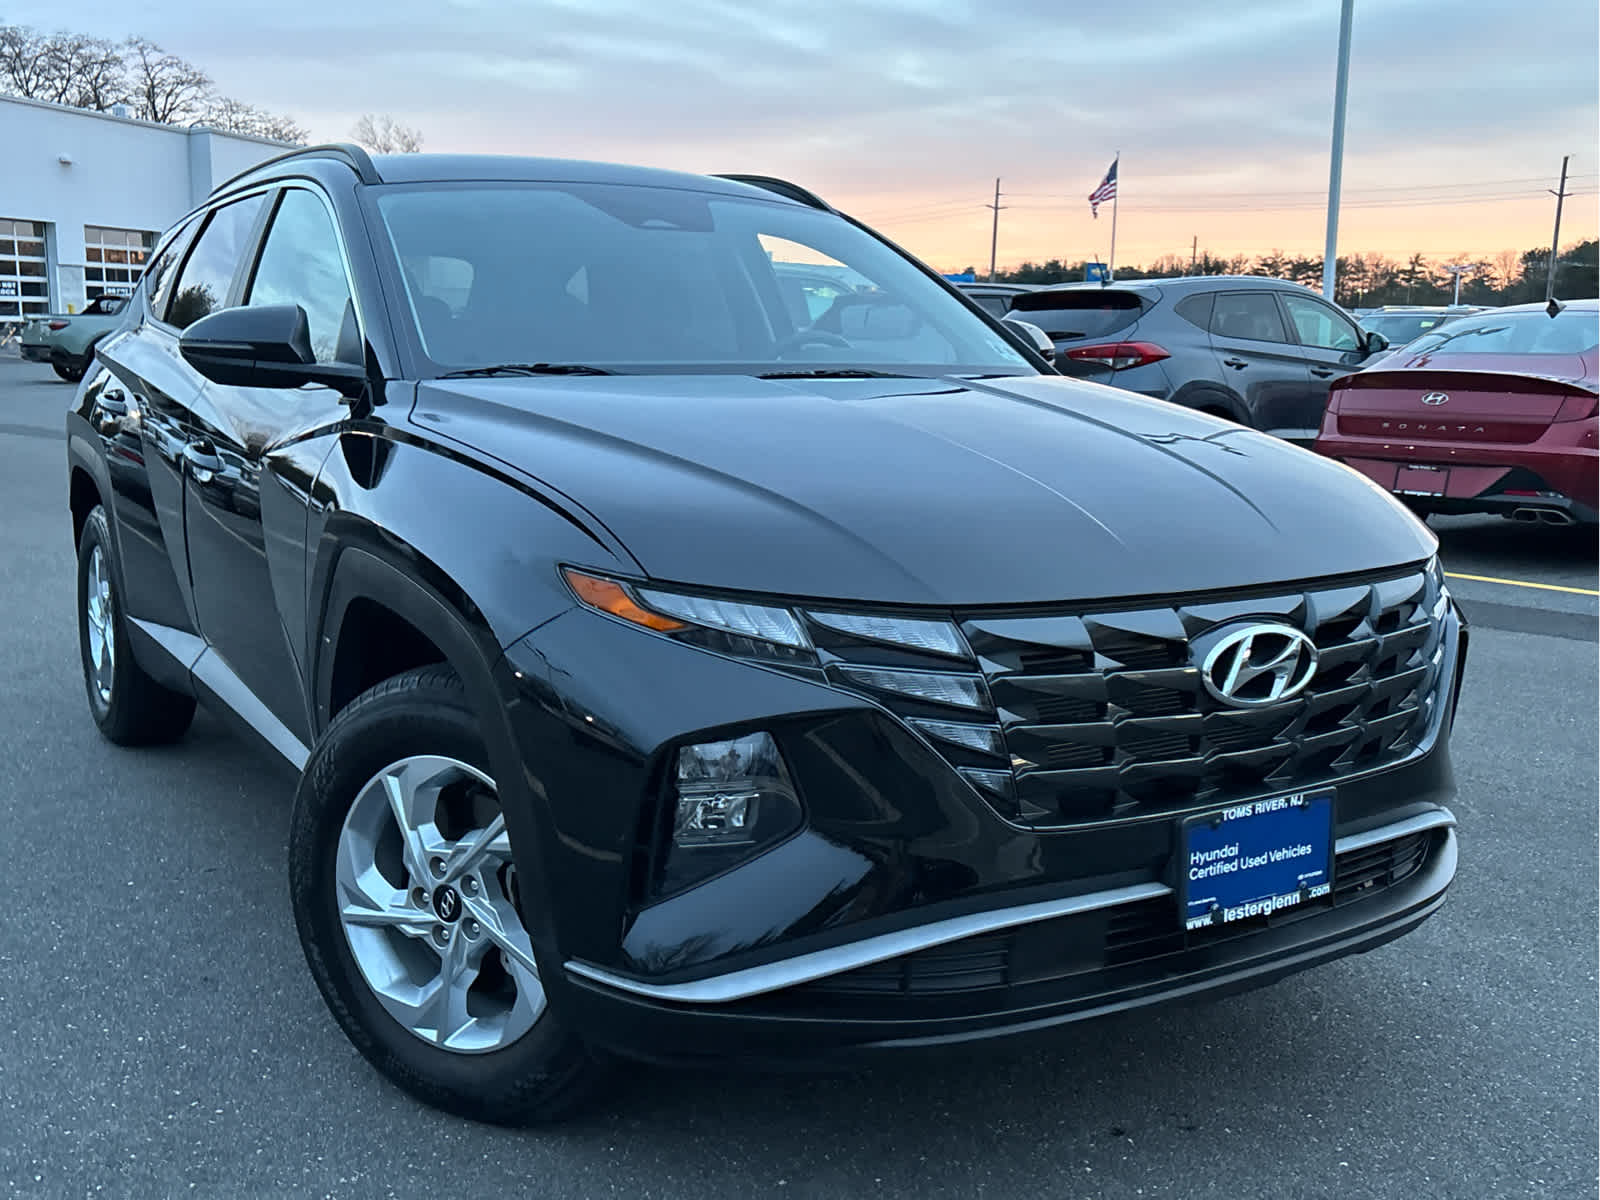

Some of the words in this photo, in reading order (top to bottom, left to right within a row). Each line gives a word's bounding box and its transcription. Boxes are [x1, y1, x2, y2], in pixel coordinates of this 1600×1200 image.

[1382, 422, 1484, 432] SONATA
[1222, 805, 1253, 822] TOMS
[1290, 794, 1304, 808] NJ
[1189, 858, 1238, 881] Certified
[1240, 851, 1268, 870] Used
[1269, 843, 1312, 863] Vehicles
[1190, 842, 1239, 866] Hyundai
[1223, 892, 1301, 923] lesterglenn
